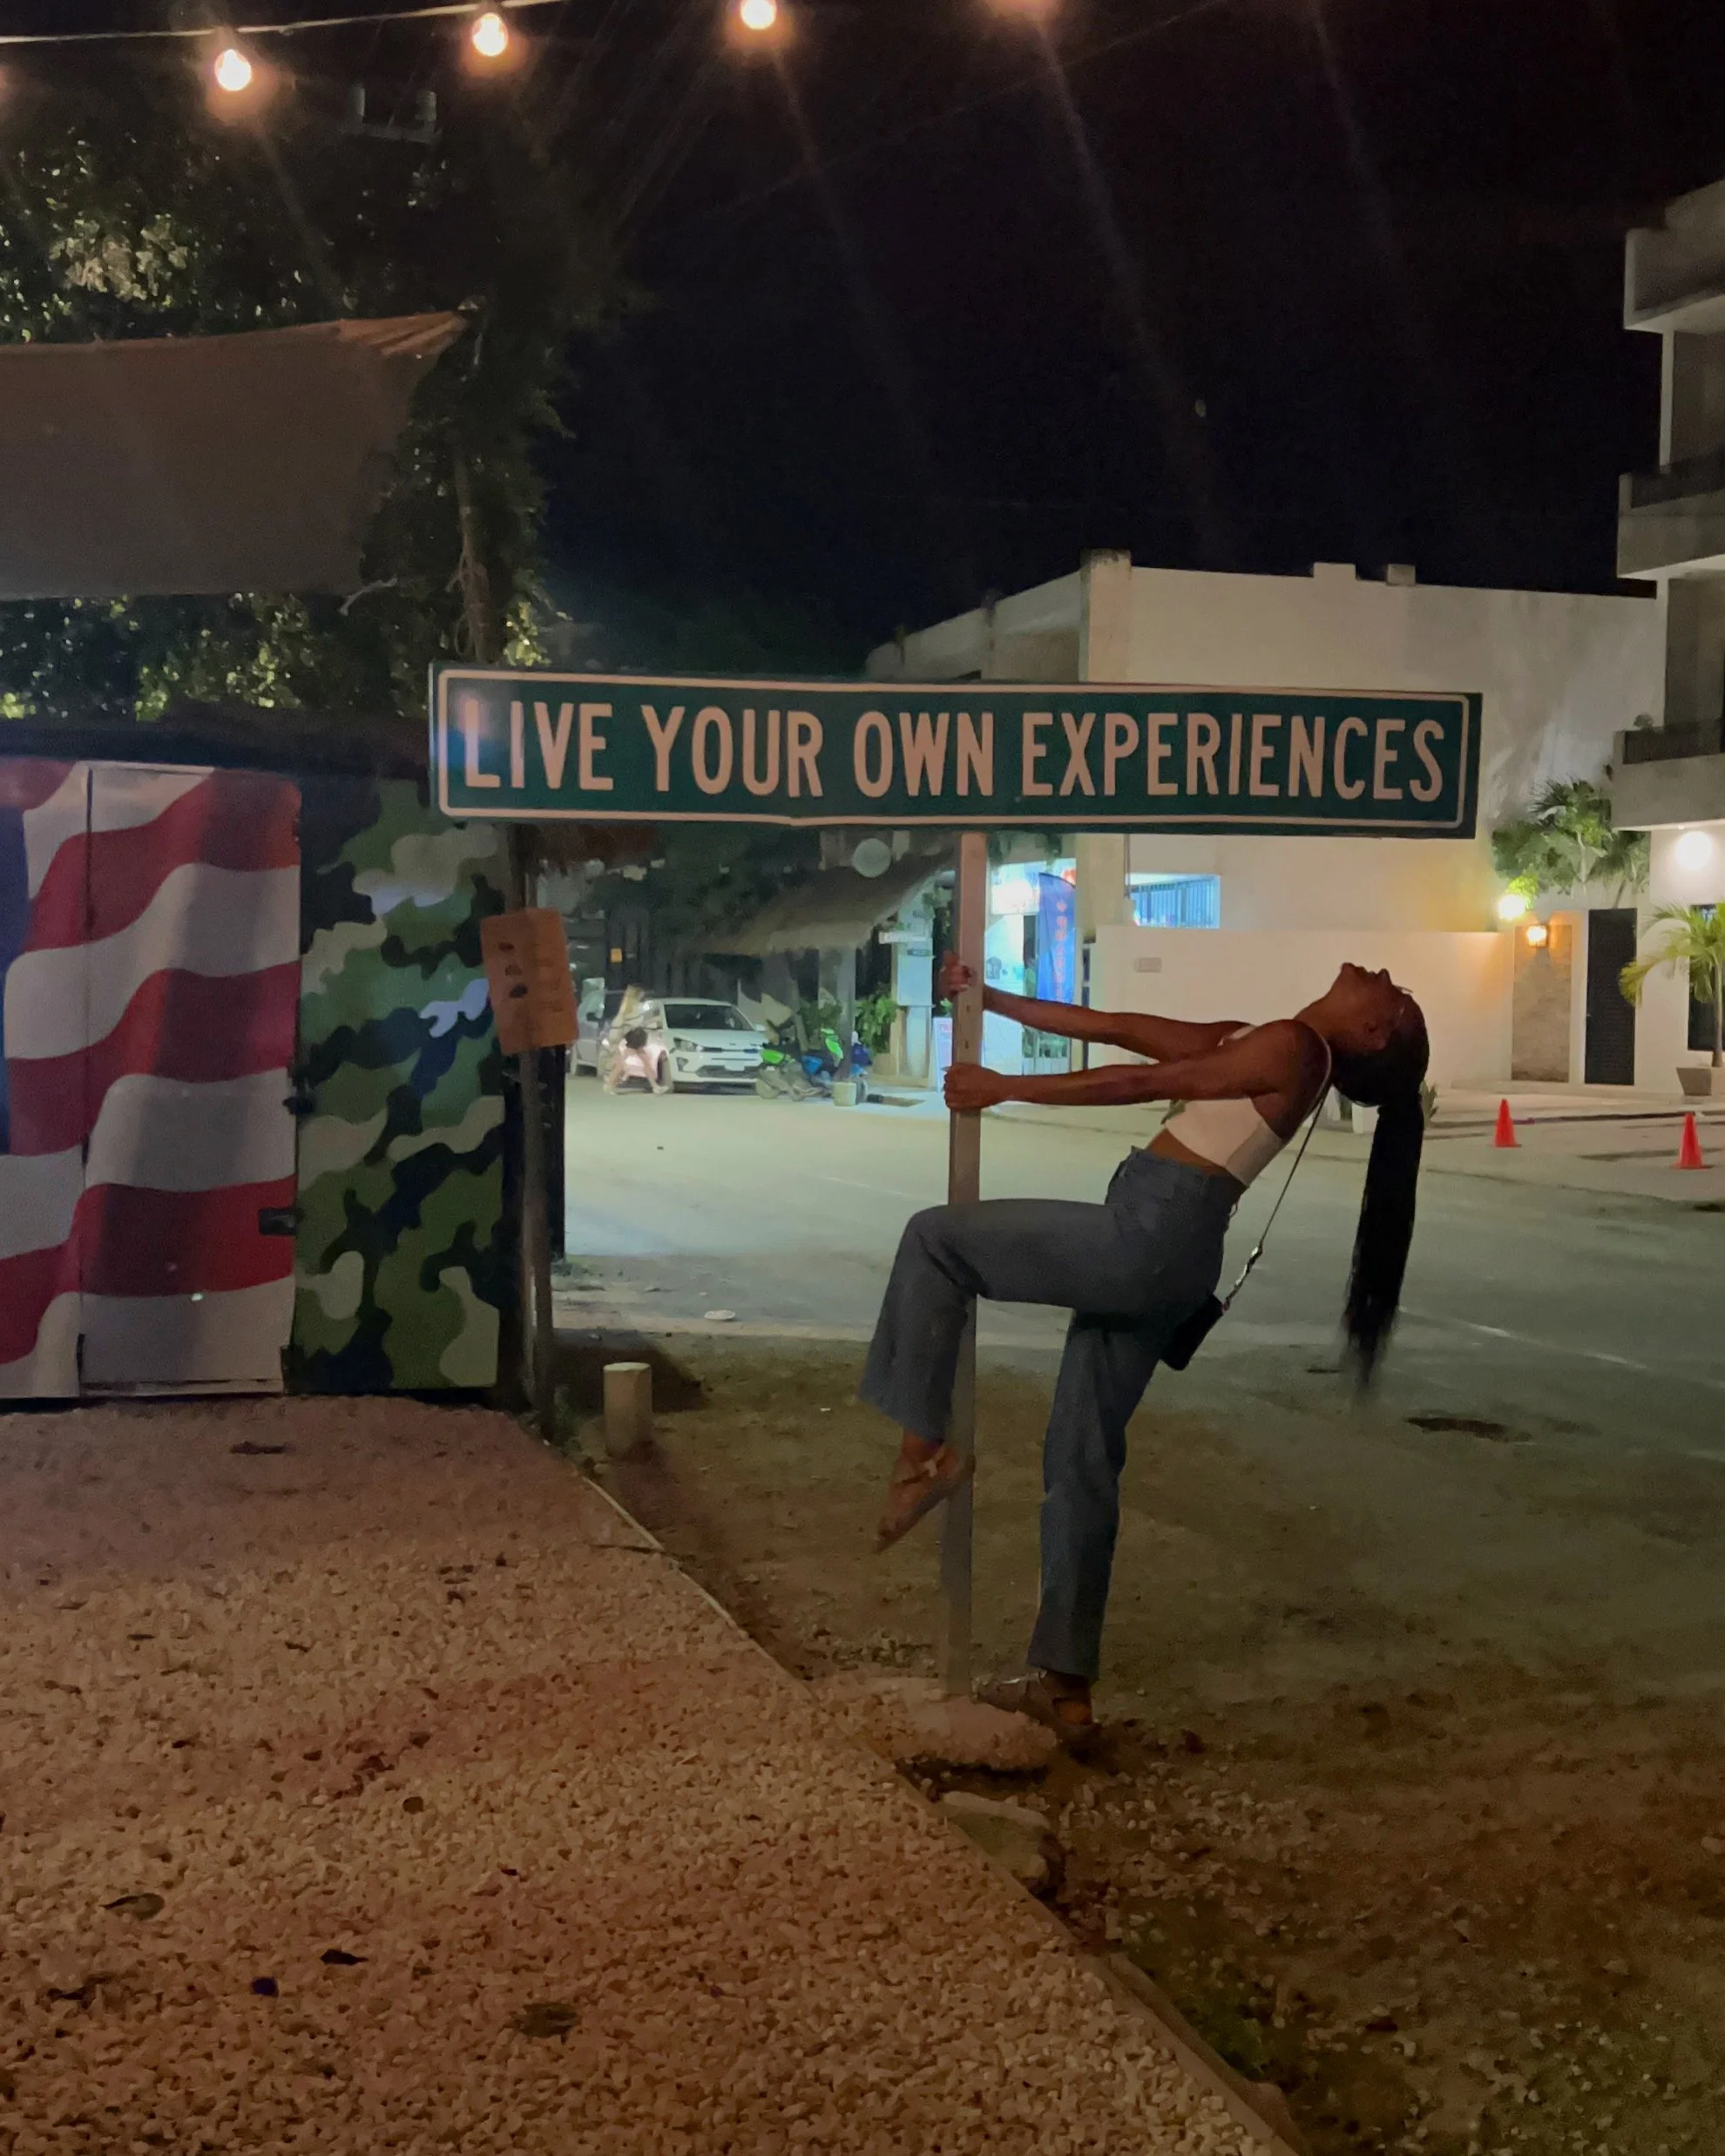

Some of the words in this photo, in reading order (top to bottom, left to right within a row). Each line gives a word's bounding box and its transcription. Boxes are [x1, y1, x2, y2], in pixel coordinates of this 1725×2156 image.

[463, 700, 613, 791] LIVE
[641, 706, 823, 798] YOUR
[853, 712, 994, 798] OWN
[1022, 713, 1444, 802] EXPERIENCES
